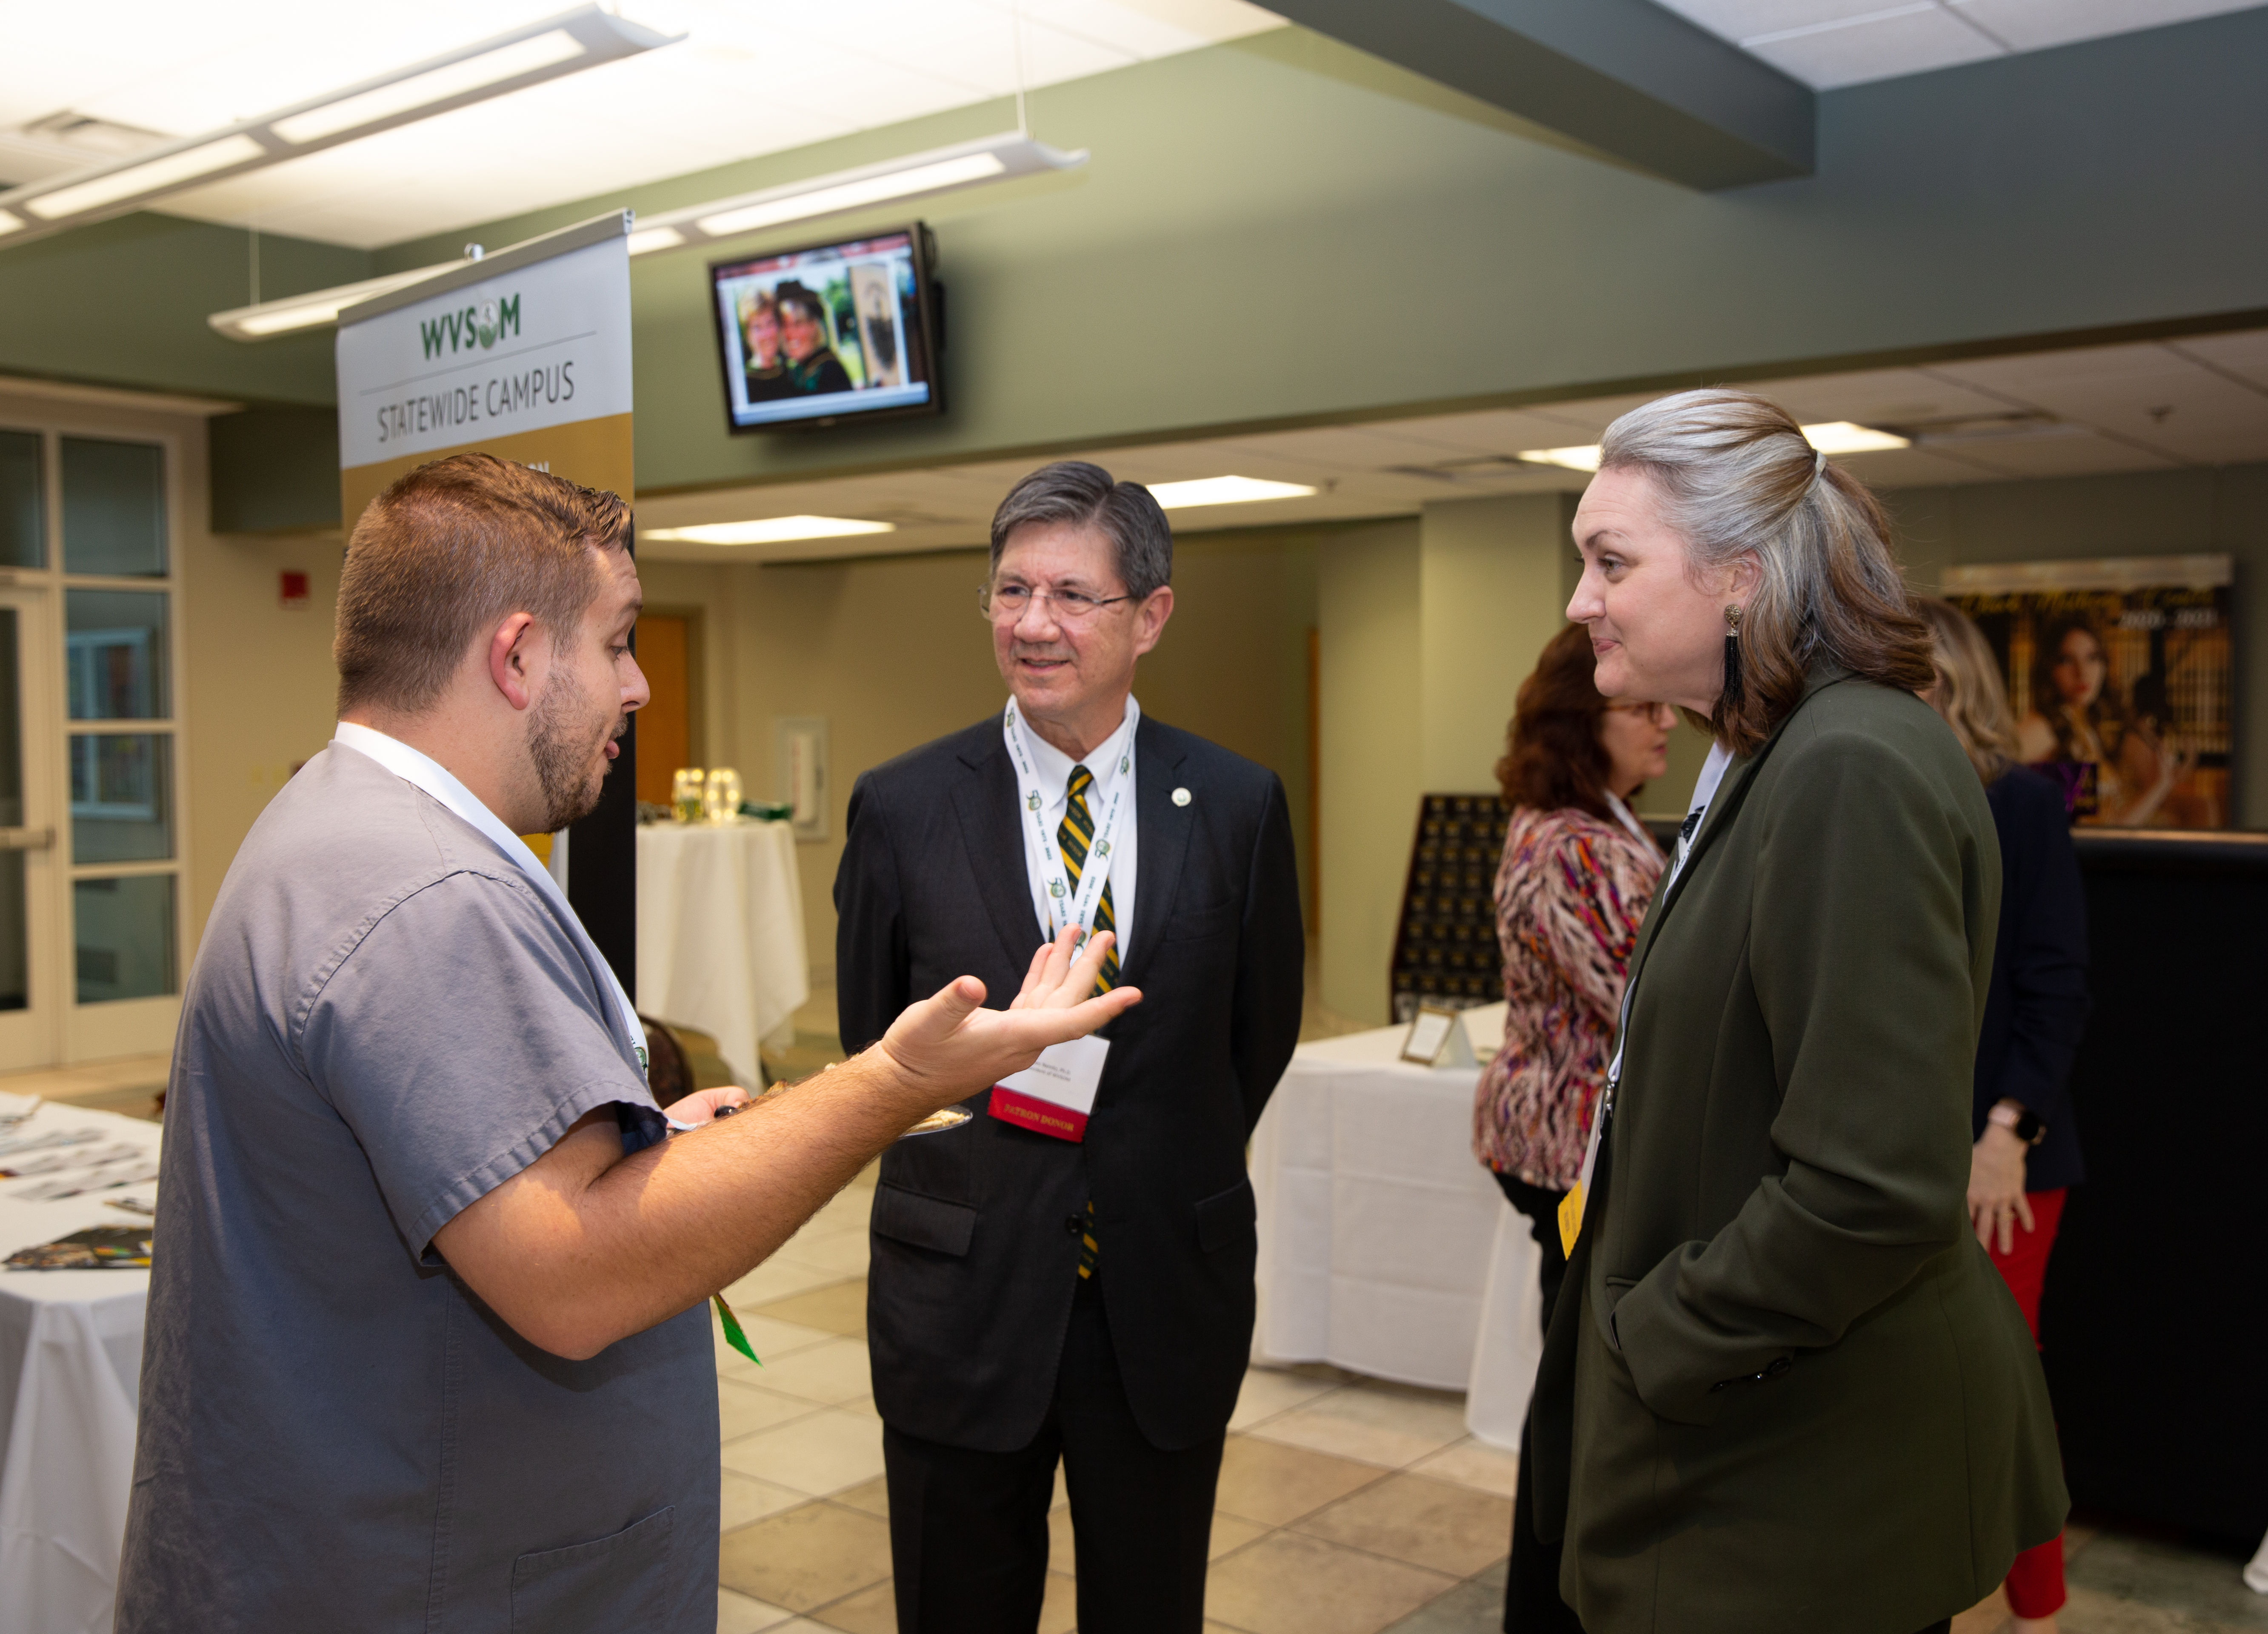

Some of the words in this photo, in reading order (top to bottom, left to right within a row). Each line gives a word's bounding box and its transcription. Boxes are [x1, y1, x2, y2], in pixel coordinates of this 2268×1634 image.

[421, 293, 520, 360] WVSOM
[378, 384, 479, 443] STATEWIDE
[485, 361, 575, 417] CAMPUS
[1003, 1103, 1040, 1123] PATRON
[1040, 1114, 1074, 1133] DONOR
